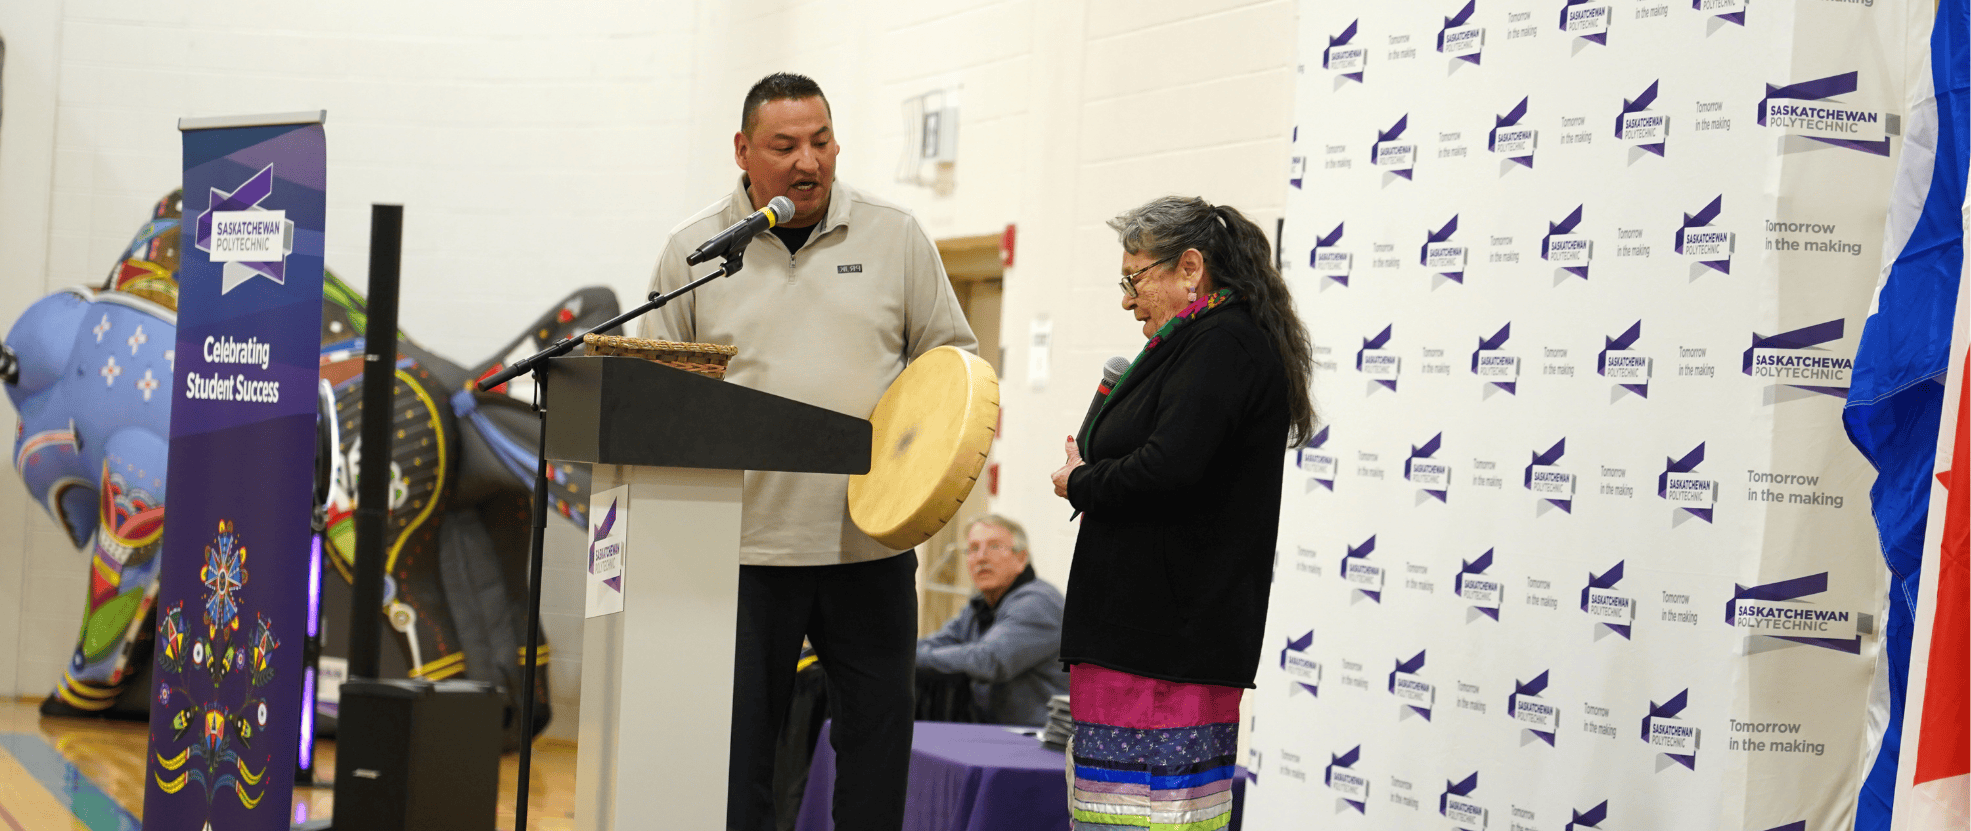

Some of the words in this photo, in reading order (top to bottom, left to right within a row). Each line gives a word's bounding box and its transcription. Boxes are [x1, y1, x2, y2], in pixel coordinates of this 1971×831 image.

[1508, 11, 1530, 22] Tomorrow
[1570, 7, 1605, 21] SASKATCHEWAN
[1636, 8, 1640, 18] in
[1650, 5, 1668, 18] making
[1569, 18, 1598, 31] POLYTECHNIC
[1446, 29, 1479, 43] SASKATCHEWAN
[1521, 25, 1537, 39] making
[1696, 101, 1722, 112] Tomorrow
[1771, 105, 1877, 122] SASKATCHEWAN
[1562, 116, 1584, 127] Tomorrow
[1626, 116, 1662, 128] SASKATCHEWAN
[1696, 119, 1701, 129] in
[1702, 118, 1710, 129] the
[1712, 118, 1730, 131] making
[1770, 118, 1858, 132] POLYTECHNIC
[1498, 130, 1531, 142] SASKATCHEWAN
[1561, 133, 1565, 143] in
[1575, 131, 1591, 144] making
[1625, 128, 1655, 139] POLYTECHNIC
[216, 220, 280, 236] SASKATCHEWAN
[1618, 228, 1642, 238] Tomorrow
[1766, 220, 1835, 234] Tomorrow
[216, 236, 270, 252] POLYTECHNIC
[1687, 233, 1727, 244] SASKATCHEWAN
[1430, 248, 1462, 256] SASKATCHEWAN
[1551, 241, 1586, 250] SASKATCHEWAN
[1617, 246, 1622, 255] in
[1632, 245, 1650, 257] making
[1685, 245, 1719, 254] POLYTECHNIC
[1766, 237, 1773, 249] in
[1775, 237, 1800, 250] the
[1804, 238, 1862, 256] making
[1550, 252, 1579, 260] POLYTECHNIC
[204, 335, 270, 370] Celebrating
[1544, 348, 1567, 357] Tomorrow
[1679, 347, 1706, 357] Tomorrow
[1481, 357, 1514, 365] SASKATCHEWAN
[1608, 357, 1645, 367] SASKATCHEWAN
[1756, 355, 1852, 370] SASKATCHEWA
[1544, 364, 1548, 373] in
[1558, 364, 1574, 376] making
[1607, 369, 1638, 377] POLYTECHNIC
[1679, 364, 1684, 374] in
[1685, 363, 1693, 375] the
[1695, 364, 1714, 378] making
[1756, 367, 1843, 380] POLYTECHNIC
[186, 372, 234, 402] Student
[236, 374, 279, 403] Success
[1413, 465, 1445, 474] SASKATCHEWAN
[1601, 466, 1625, 477] Tomorrow
[1534, 472, 1569, 483] SASKATCHEWAN
[1748, 470, 1819, 486] Tomorrow
[1533, 483, 1562, 492] POLYTECHNIC
[1600, 484, 1605, 494] in
[1615, 484, 1633, 498] making
[1670, 480, 1710, 490] SASKATCHEWAN
[1669, 491, 1702, 501] POLYTECHNIC
[1748, 488, 1756, 501] in
[1758, 488, 1784, 502] the
[1789, 489, 1844, 508] making
[1464, 580, 1497, 591] SASKATCHEWAN
[1527, 578, 1550, 589] Tomorrow
[1541, 596, 1557, 610] making
[1592, 594, 1628, 606] SASKATCHEWAN
[1662, 592, 1689, 604] Tomorrow
[1591, 605, 1622, 617] POLYTECHNIC
[1662, 609, 1667, 620] in
[1668, 609, 1676, 621] the
[1678, 610, 1697, 626] making
[1739, 606, 1849, 621] SASKATCHEWAN
[1738, 616, 1828, 631] POLYTECHNIC
[1398, 679, 1429, 692] SASKATCHEWAN
[1518, 701, 1553, 715] SASKATCHEWAN
[1585, 704, 1609, 717] Tomorrow
[1517, 711, 1546, 725] POLYTECHNIC
[1584, 721, 1589, 730] in
[1599, 722, 1616, 737] making
[1653, 724, 1692, 737] SASKATCHEWAN
[1731, 721, 1801, 734] Tomorrow
[1652, 736, 1684, 748] POLYTECHNIC
[1730, 738, 1739, 750] in
[1741, 737, 1766, 751] the
[1770, 738, 1825, 756] making
[1449, 800, 1482, 816] SASKATCHEWAN
[1511, 806, 1534, 820] Tomorrow
